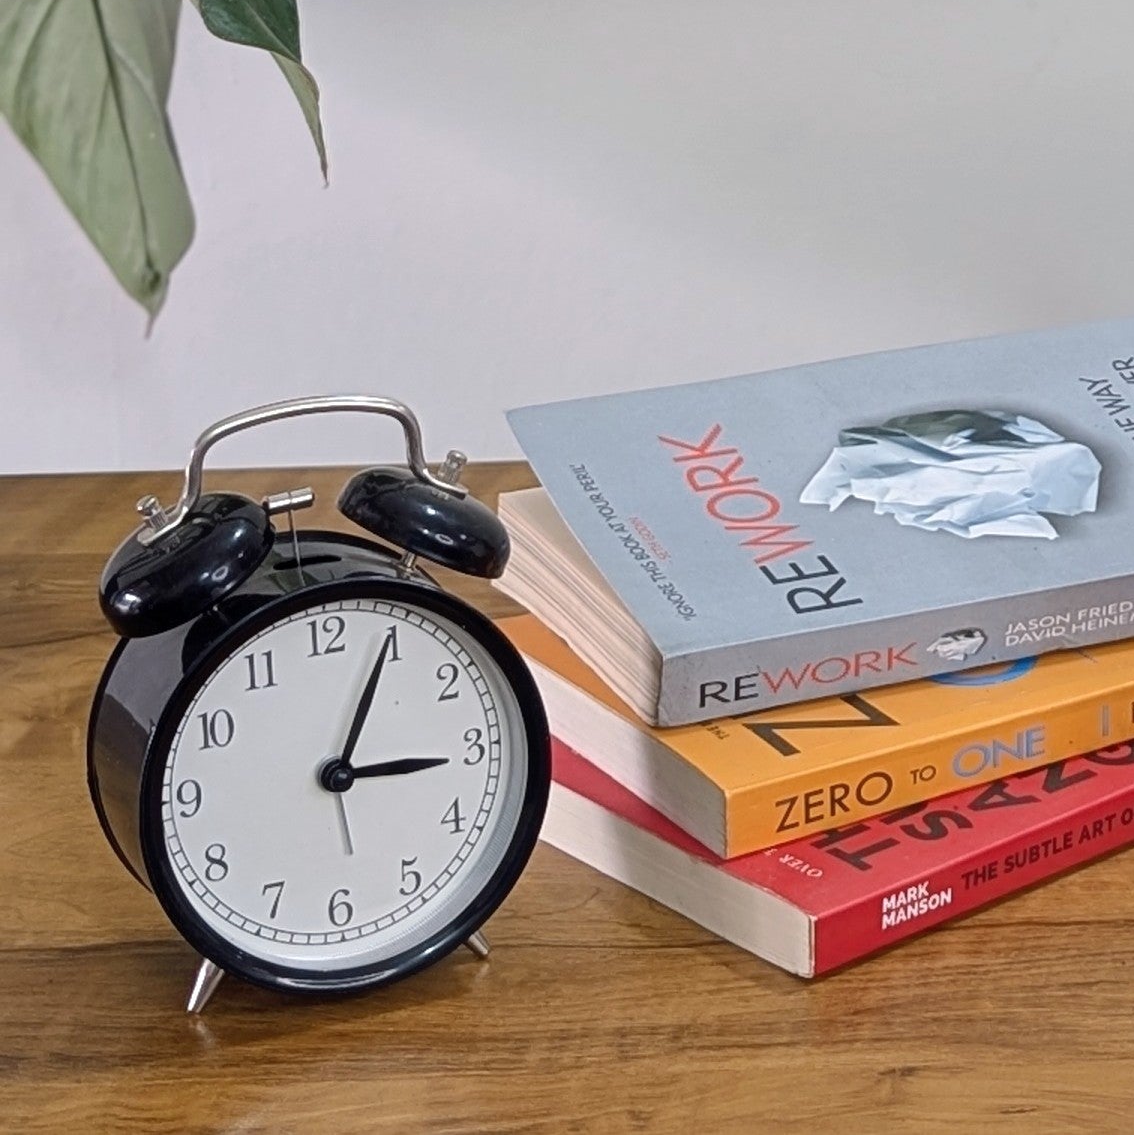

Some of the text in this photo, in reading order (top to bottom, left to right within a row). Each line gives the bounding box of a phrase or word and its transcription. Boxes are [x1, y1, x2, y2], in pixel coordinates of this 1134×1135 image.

[1078, 377, 1131, 416] WAY
[589, 493, 618, 523] YOUR
[657, 423, 863, 614] REWORK
[609, 521, 629, 536] AT
[619, 533, 651, 561] BOOK
[640, 560, 667, 583] THIS
[307, 616, 346, 658] 12
[1005, 613, 1070, 636] JASON
[1078, 601, 1134, 622] FRIED
[1005, 626, 1066, 647] DAVID
[386, 624, 402, 662] 1
[244, 649, 278, 692] 11
[436, 663, 460, 702] 2
[699, 642, 918, 708] REWORK
[197, 708, 235, 751] 10
[463, 727, 486, 766] 3
[176, 779, 202, 818] 9
[775, 771, 893, 833] ZERO
[910, 765, 937, 784] TO
[952, 725, 1046, 778] ONE
[440, 796, 466, 834] 4
[204, 843, 229, 882] 8
[779, 853, 824, 878] OVER
[961, 861, 998, 890] THE
[1003, 832, 1073, 874] SUBTLE
[1079, 814, 1118, 845] ART
[399, 856, 422, 896] 5
[262, 881, 285, 919] 7
[328, 889, 353, 927] 6
[882, 881, 930, 913] MARK
[882, 888, 952, 930] MANSON
